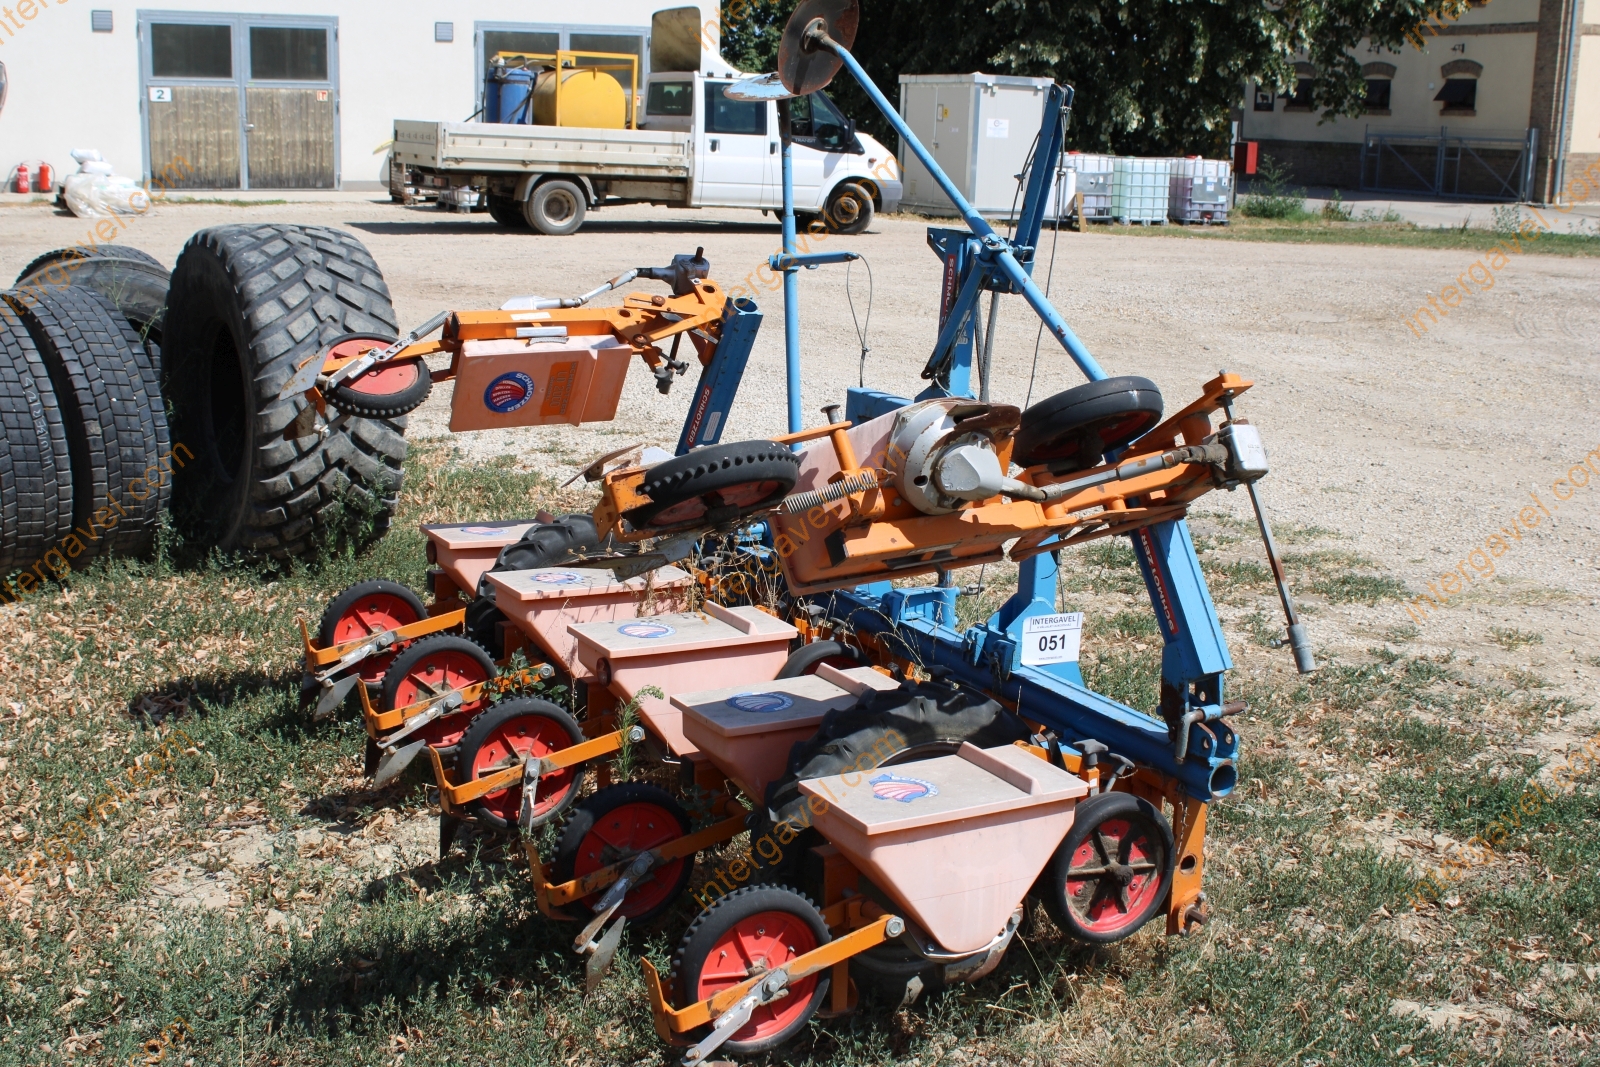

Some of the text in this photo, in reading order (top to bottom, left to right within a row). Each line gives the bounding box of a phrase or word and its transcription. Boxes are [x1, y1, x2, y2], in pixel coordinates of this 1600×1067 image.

[156, 89, 165, 99] 2
[507, 371, 535, 413] SCHMOTZER
[688, 388, 710, 443] SCHMOTZER
[1140, 534, 1175, 631] SCHMOTZER
[1032, 615, 1076, 626] INTERGAVEL
[1038, 633, 1066, 652] 051
